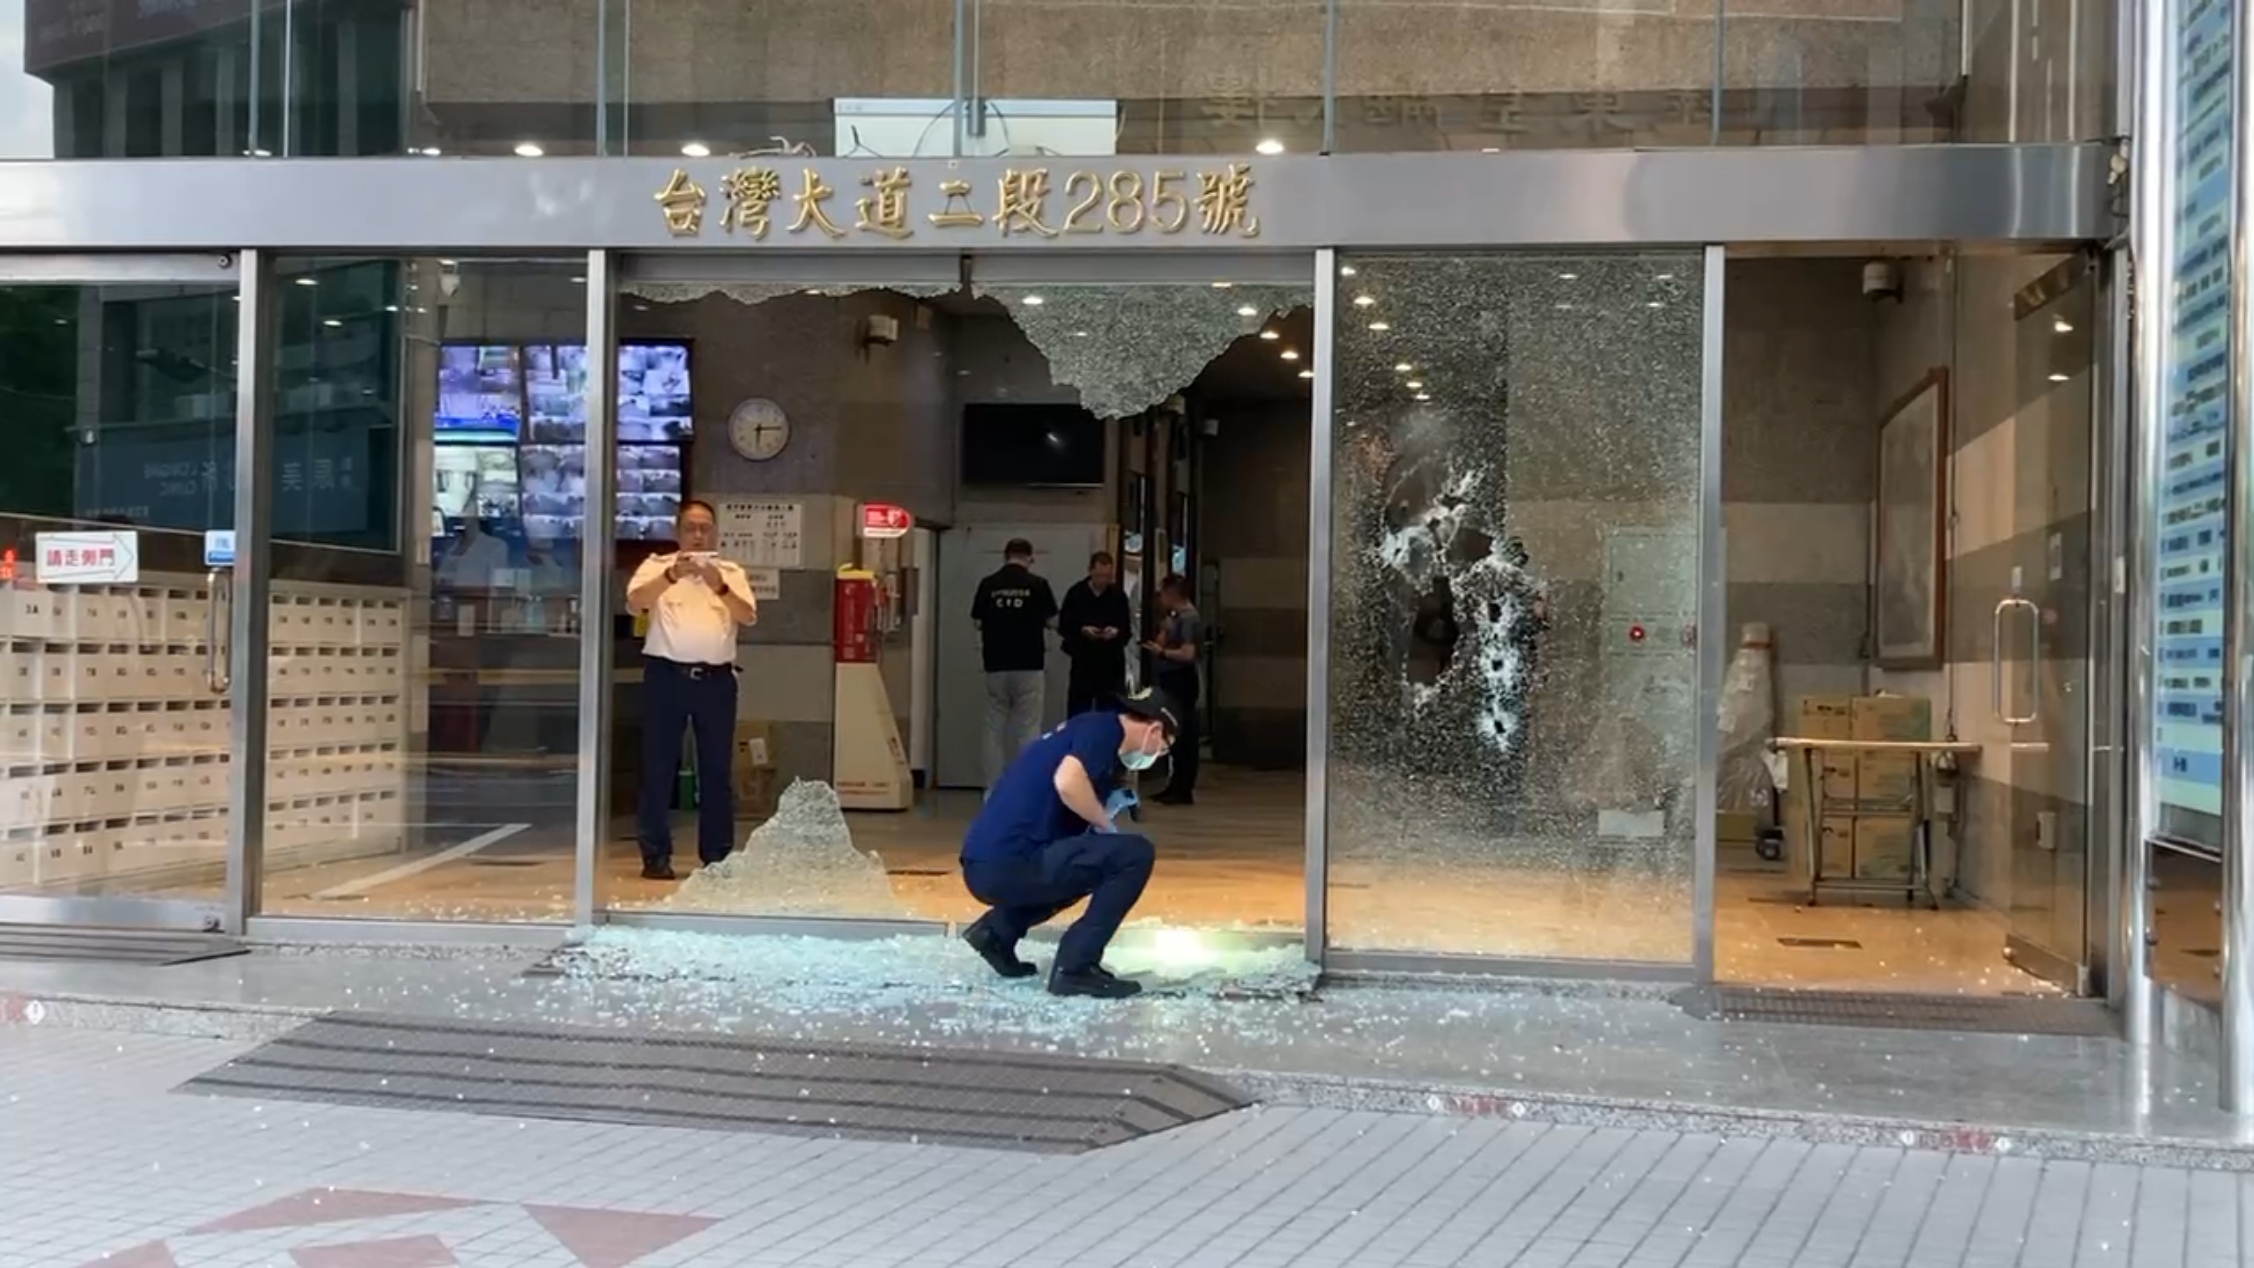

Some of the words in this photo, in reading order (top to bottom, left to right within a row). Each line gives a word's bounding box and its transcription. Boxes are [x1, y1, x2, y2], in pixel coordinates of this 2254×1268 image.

[655, 163, 1261, 241] 台灣大道二段285號
